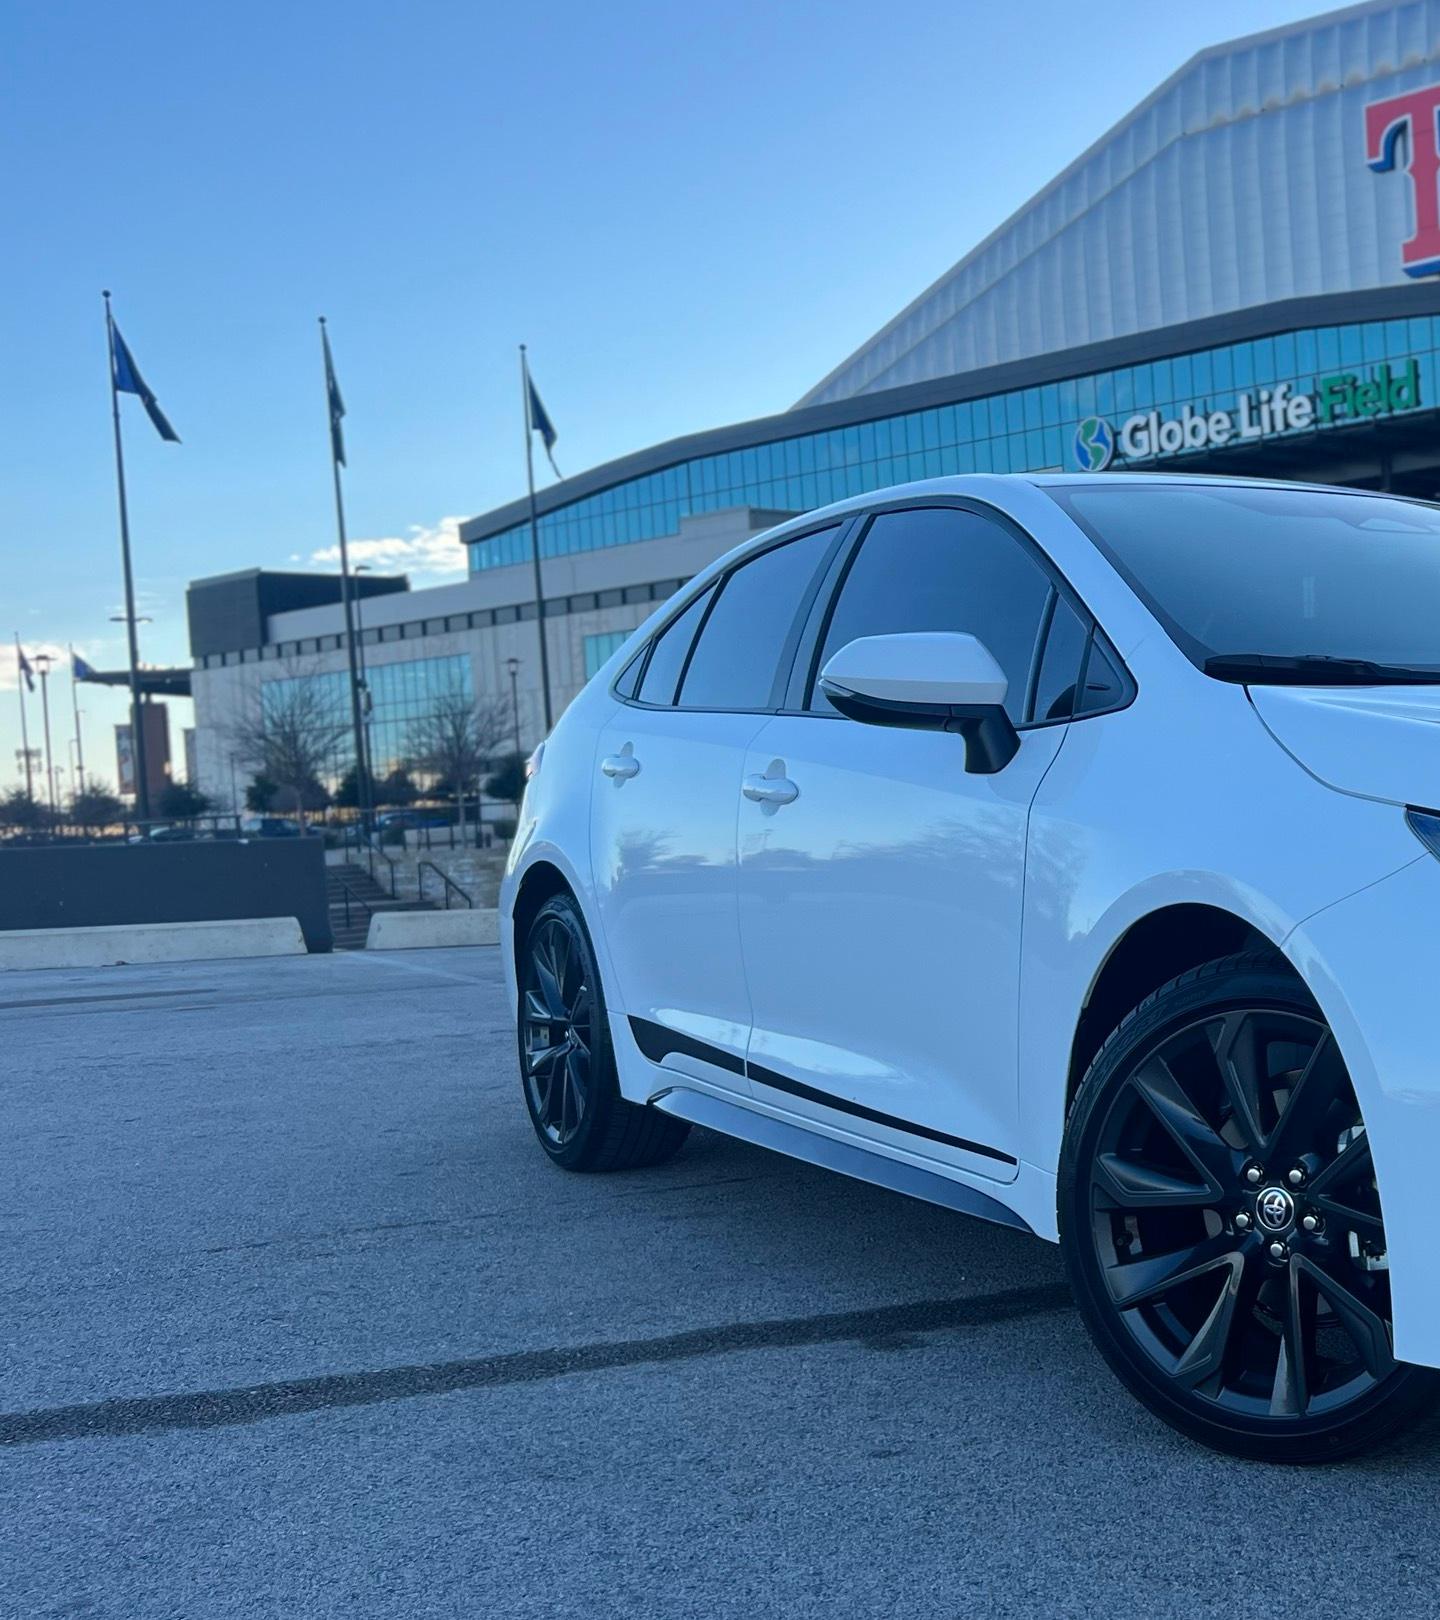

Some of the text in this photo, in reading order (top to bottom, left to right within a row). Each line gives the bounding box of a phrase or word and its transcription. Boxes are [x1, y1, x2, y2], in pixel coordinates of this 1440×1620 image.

[1121, 358, 1421, 457] Globe Life Field
